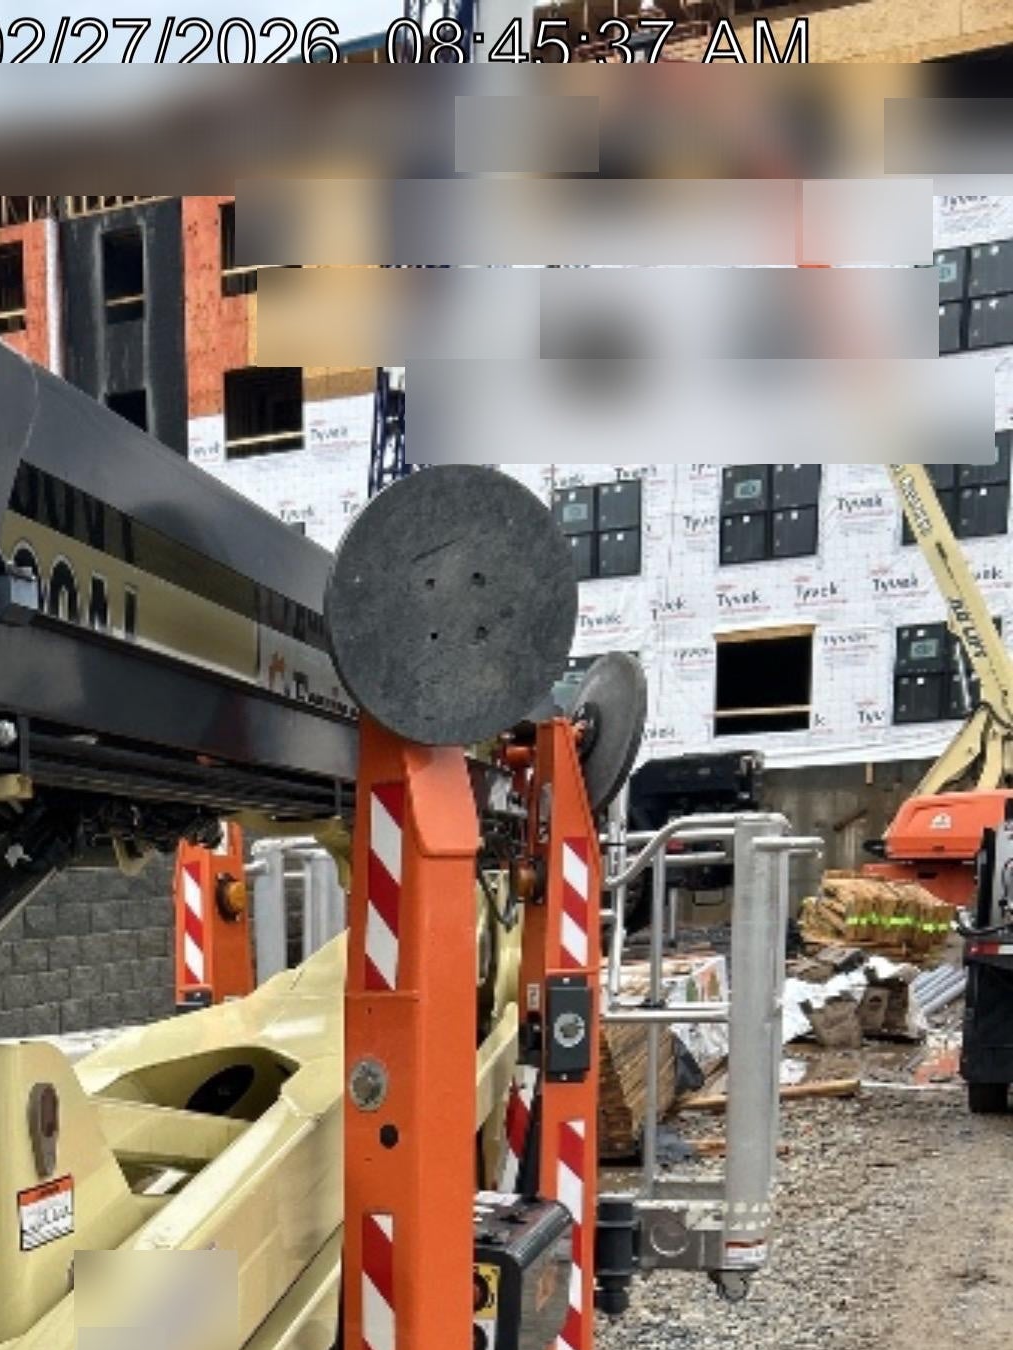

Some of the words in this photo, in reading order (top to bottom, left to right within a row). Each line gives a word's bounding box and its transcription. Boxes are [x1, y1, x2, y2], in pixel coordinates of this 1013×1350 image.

[838, 492, 882, 513] Tyvek
[873, 573, 918, 592] Tyvek
[717, 590, 759, 607] Tyvek
